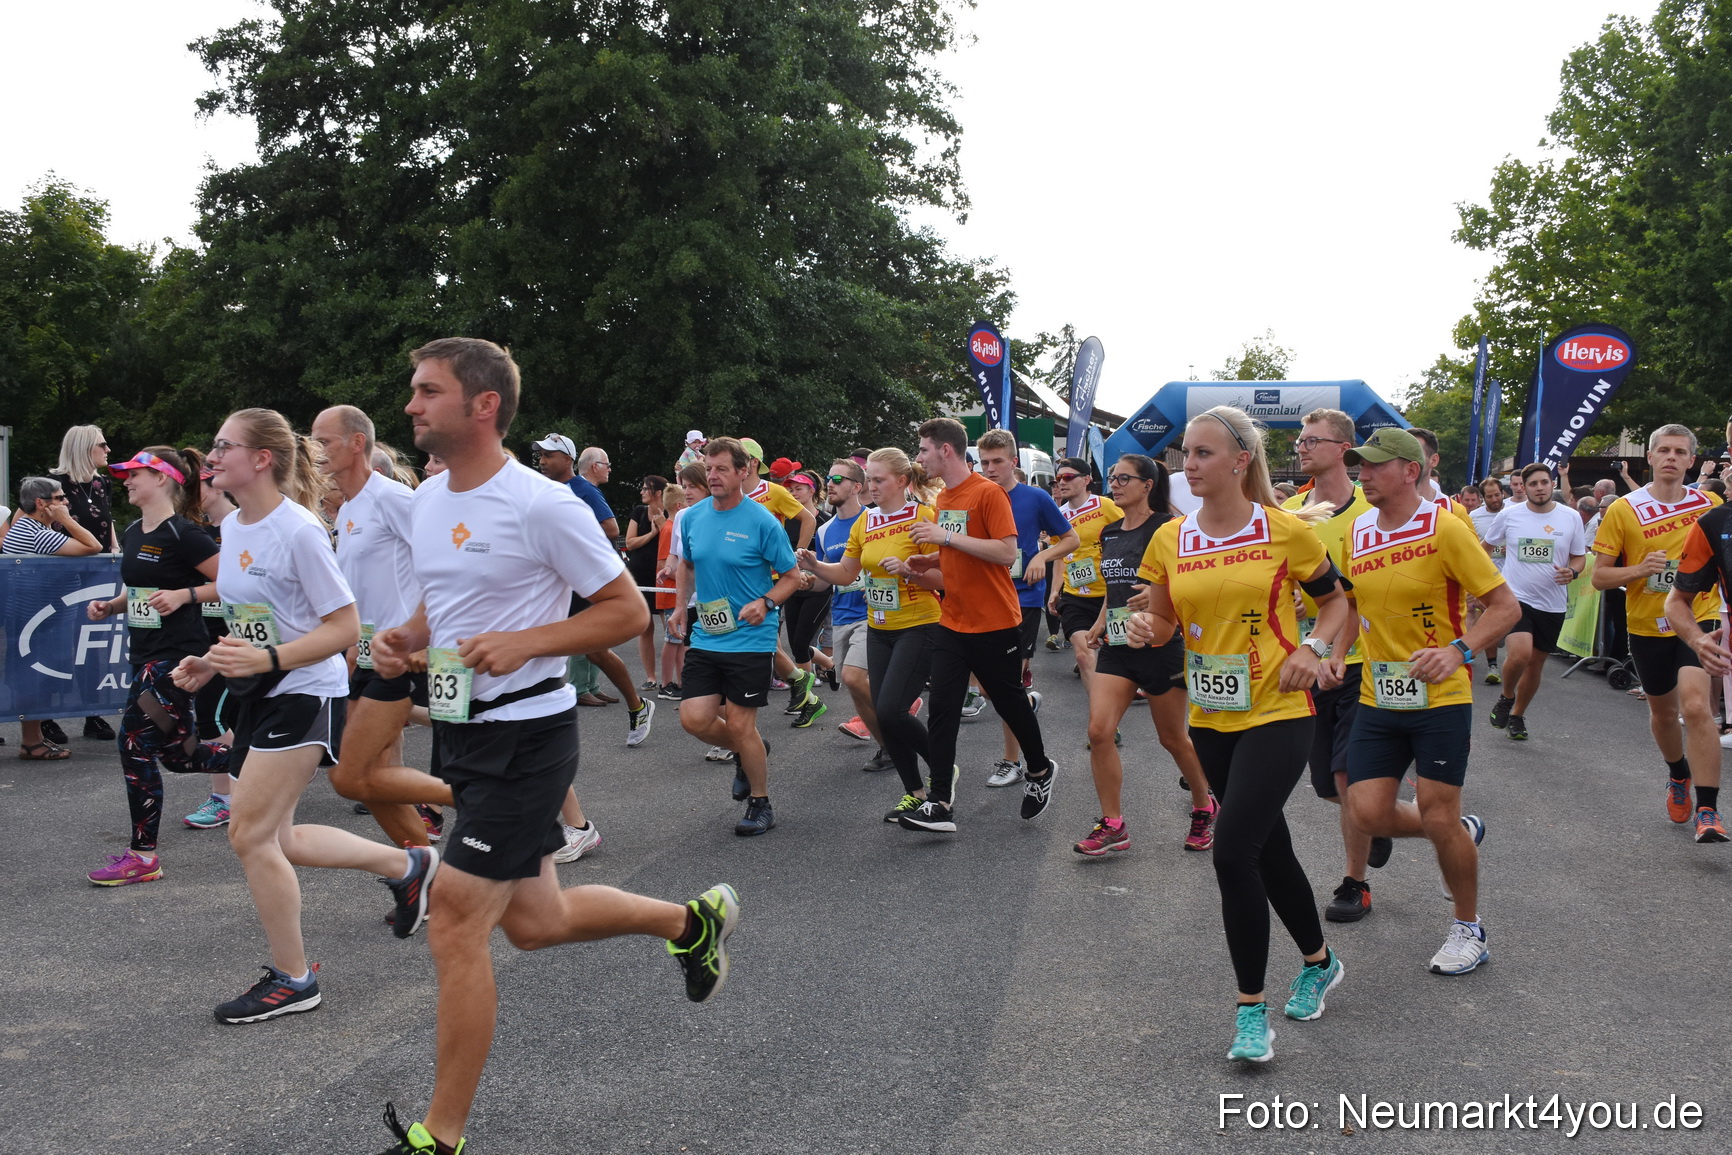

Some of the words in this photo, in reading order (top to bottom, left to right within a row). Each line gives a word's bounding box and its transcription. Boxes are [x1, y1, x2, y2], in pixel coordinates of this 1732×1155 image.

[1563, 342, 1624, 364] Hervis
[1245, 404, 1302, 416] firmenlauf
[1137, 422, 1168, 431] Fischer
[1078, 511, 1104, 525] BÖGL
[864, 530, 887, 543] MAX
[889, 523, 914, 537] BÖG
[1643, 520, 1678, 540] MAX
[1522, 546, 1549, 557] 1368
[1177, 558, 1217, 575] MAX
[1223, 550, 1273, 566] BÖGL
[1351, 557, 1386, 578] MAX
[1391, 543, 1438, 565] BÖGL
[1071, 567, 1092, 581] 1603
[1103, 567, 1139, 578] DESIGN
[868, 588, 894, 602] 1675
[131, 602, 150, 617] 143
[700, 612, 728, 626] 1860
[1109, 619, 1130, 636] 101
[1192, 671, 1239, 695] 1559
[1378, 678, 1418, 696] 1584
[462, 836, 492, 853] adidas
